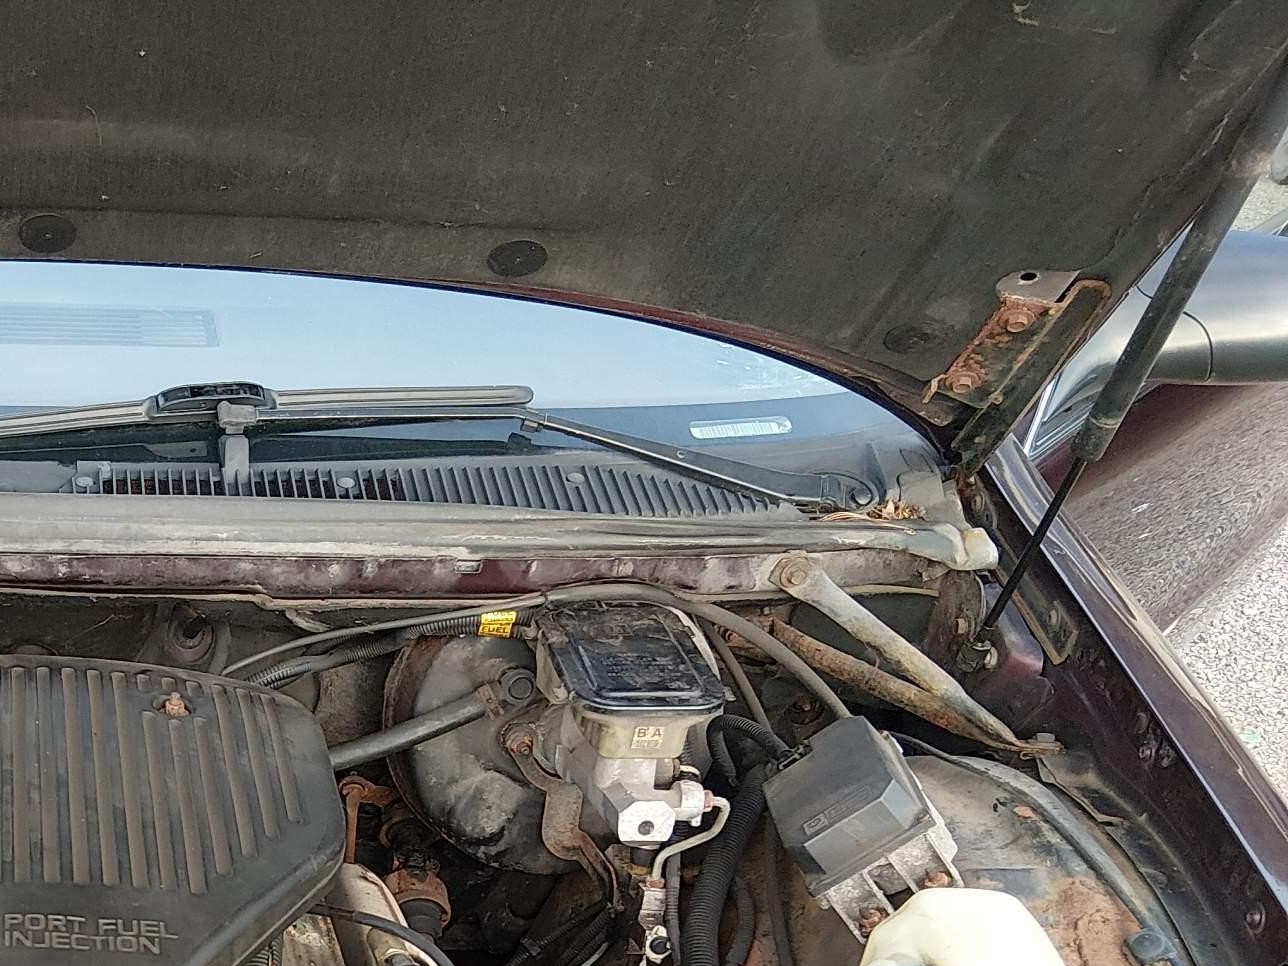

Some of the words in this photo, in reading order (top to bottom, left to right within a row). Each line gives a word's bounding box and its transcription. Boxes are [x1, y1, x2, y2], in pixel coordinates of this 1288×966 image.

[4, 913, 86, 934] PORT
[98, 918, 179, 940] FUEL
[4, 930, 161, 955] INJECTION
